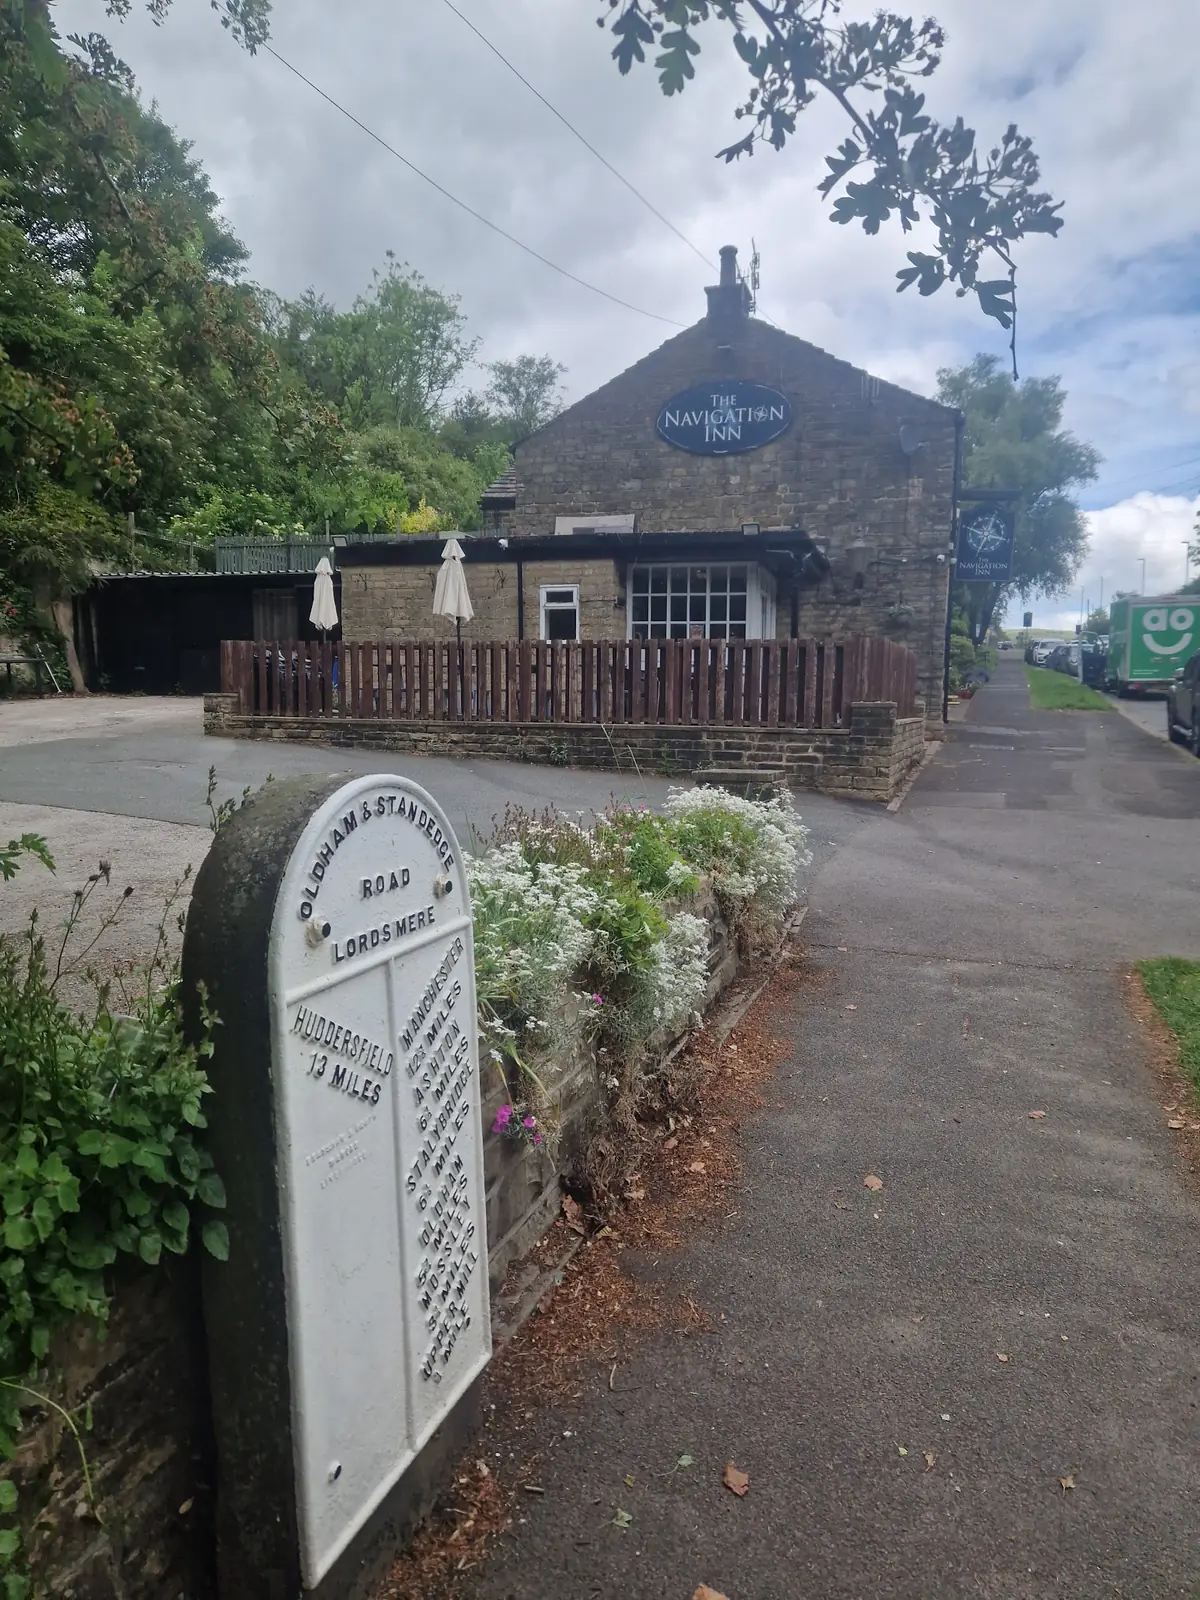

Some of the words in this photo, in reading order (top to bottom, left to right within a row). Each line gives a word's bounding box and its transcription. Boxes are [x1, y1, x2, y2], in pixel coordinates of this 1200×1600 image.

[704, 425, 742, 442] INN
[710, 394, 737, 406] THE
[1143, 608, 1194, 631] ao
[300, 810, 358, 919] OLDHAM
[361, 800, 372, 820] &
[375, 796, 454, 872] STANDEDGE
[362, 868, 410, 898] ROAD
[402, 937, 464, 1047] MANCHESTER
[427, 980, 462, 1046] MILES
[294, 1005, 394, 1076] HUDDERSFIELD
[415, 1020, 460, 1105] ASHTON
[435, 1036, 469, 1101] MILES
[309, 1052, 326, 1077] 13
[331, 1064, 381, 1105] MILES
[407, 1059, 474, 1192] STALYBRIDGE
[435, 1101, 470, 1176] MILES
[421, 1154, 464, 1246] OLDHAM
[433, 1174, 468, 1251] MILES
[421, 1195, 471, 1310] MOSSLEY
[441, 1221, 475, 1303] MILES
[444, 1299, 469, 1363] MILE
